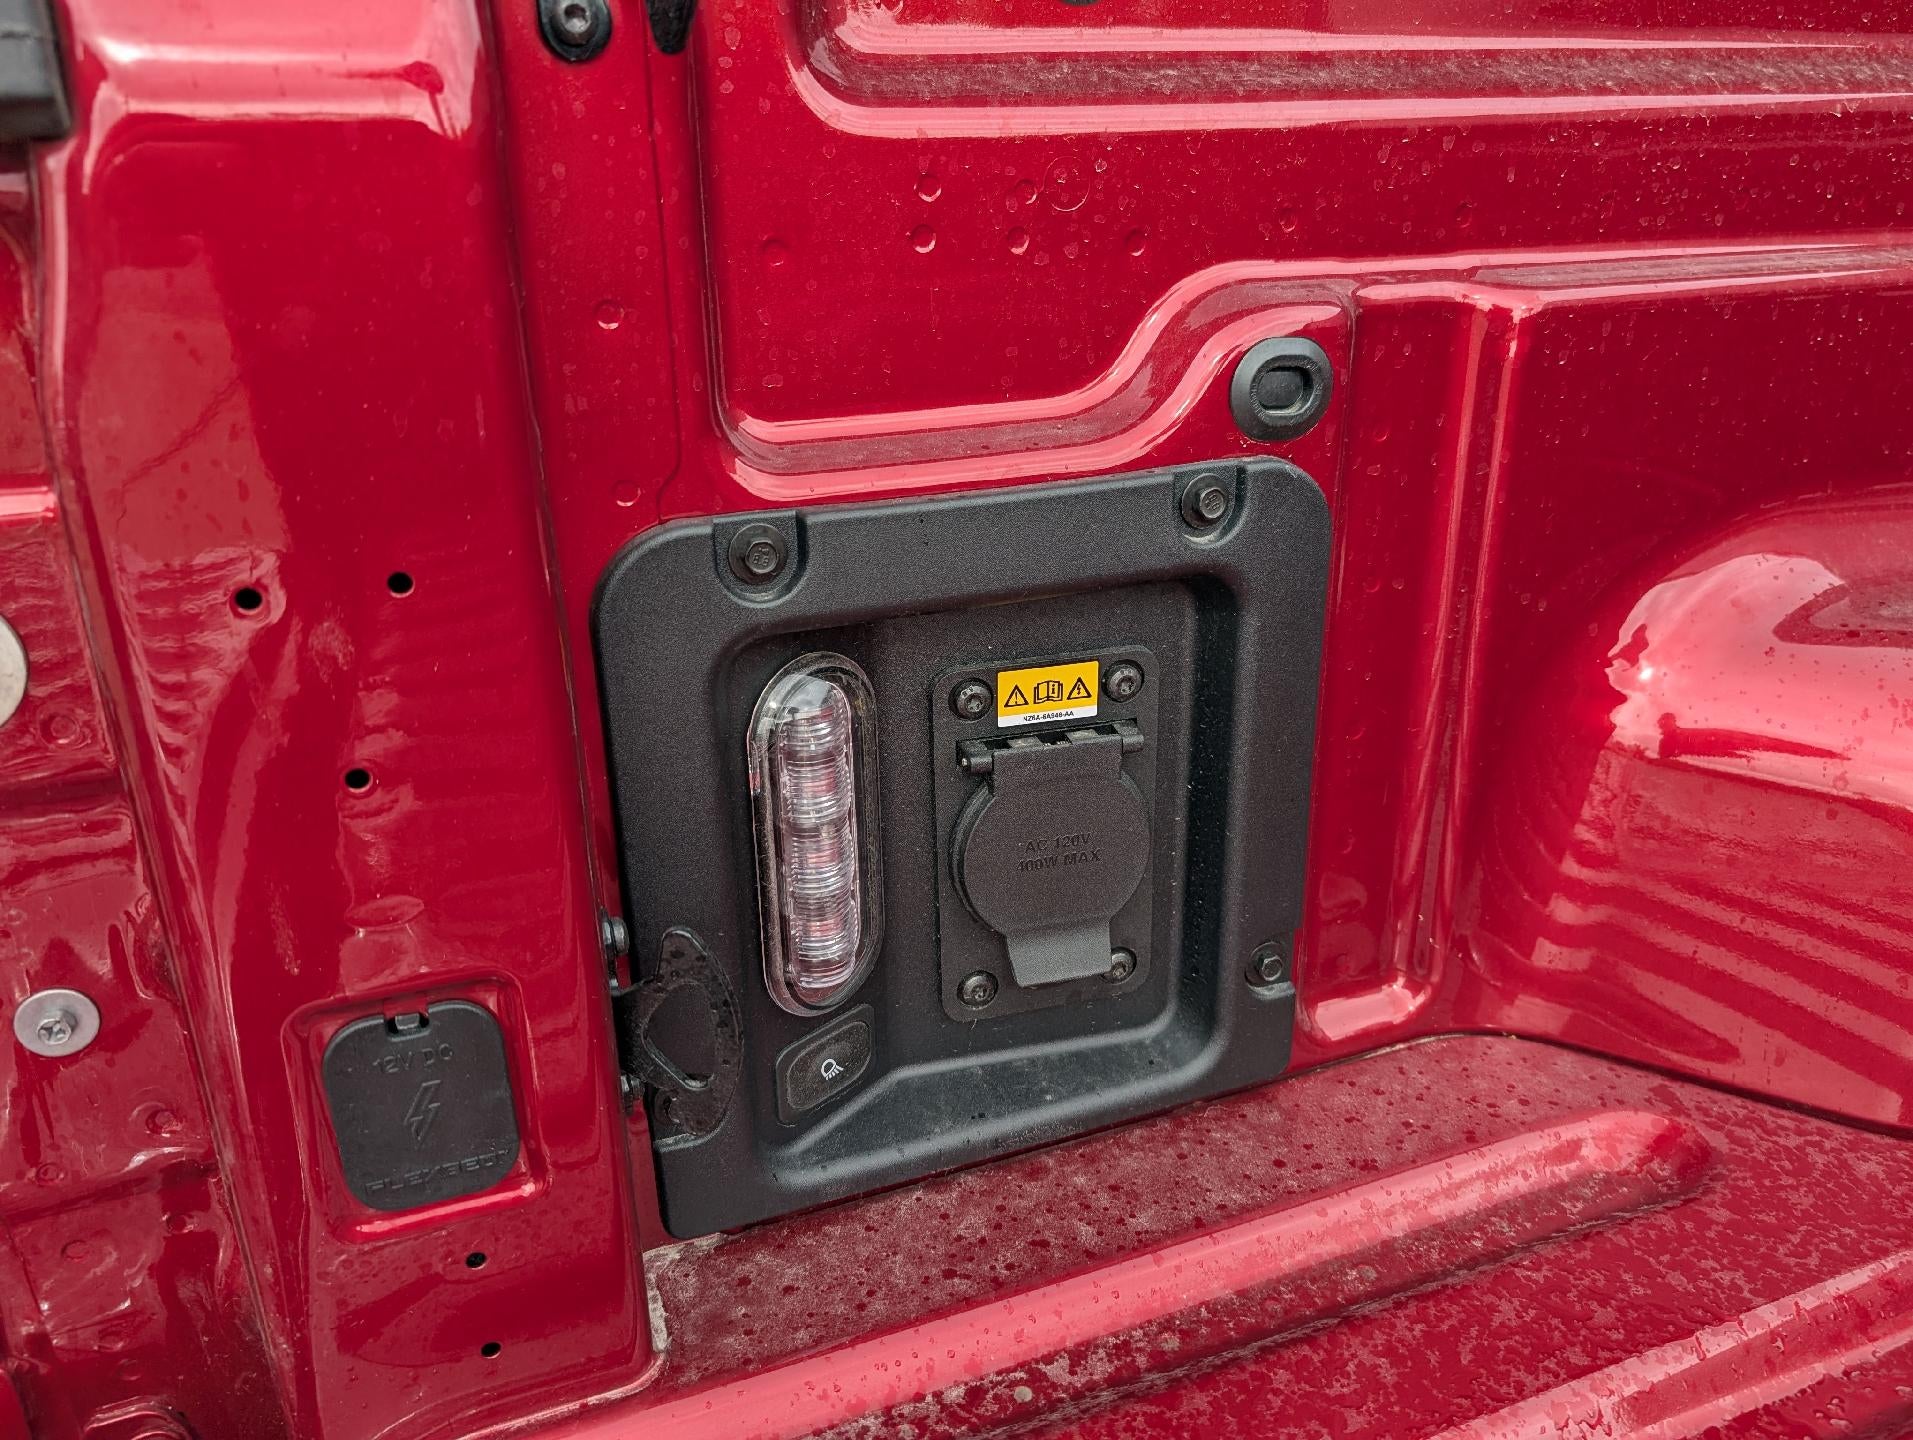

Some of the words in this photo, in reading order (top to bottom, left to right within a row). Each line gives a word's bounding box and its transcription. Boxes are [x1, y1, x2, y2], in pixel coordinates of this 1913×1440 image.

[1025, 838, 1048, 854] AC
[1054, 831, 1092, 849] 120V
[1063, 848, 1101, 865] MAX
[373, 1051, 412, 1073] 12V
